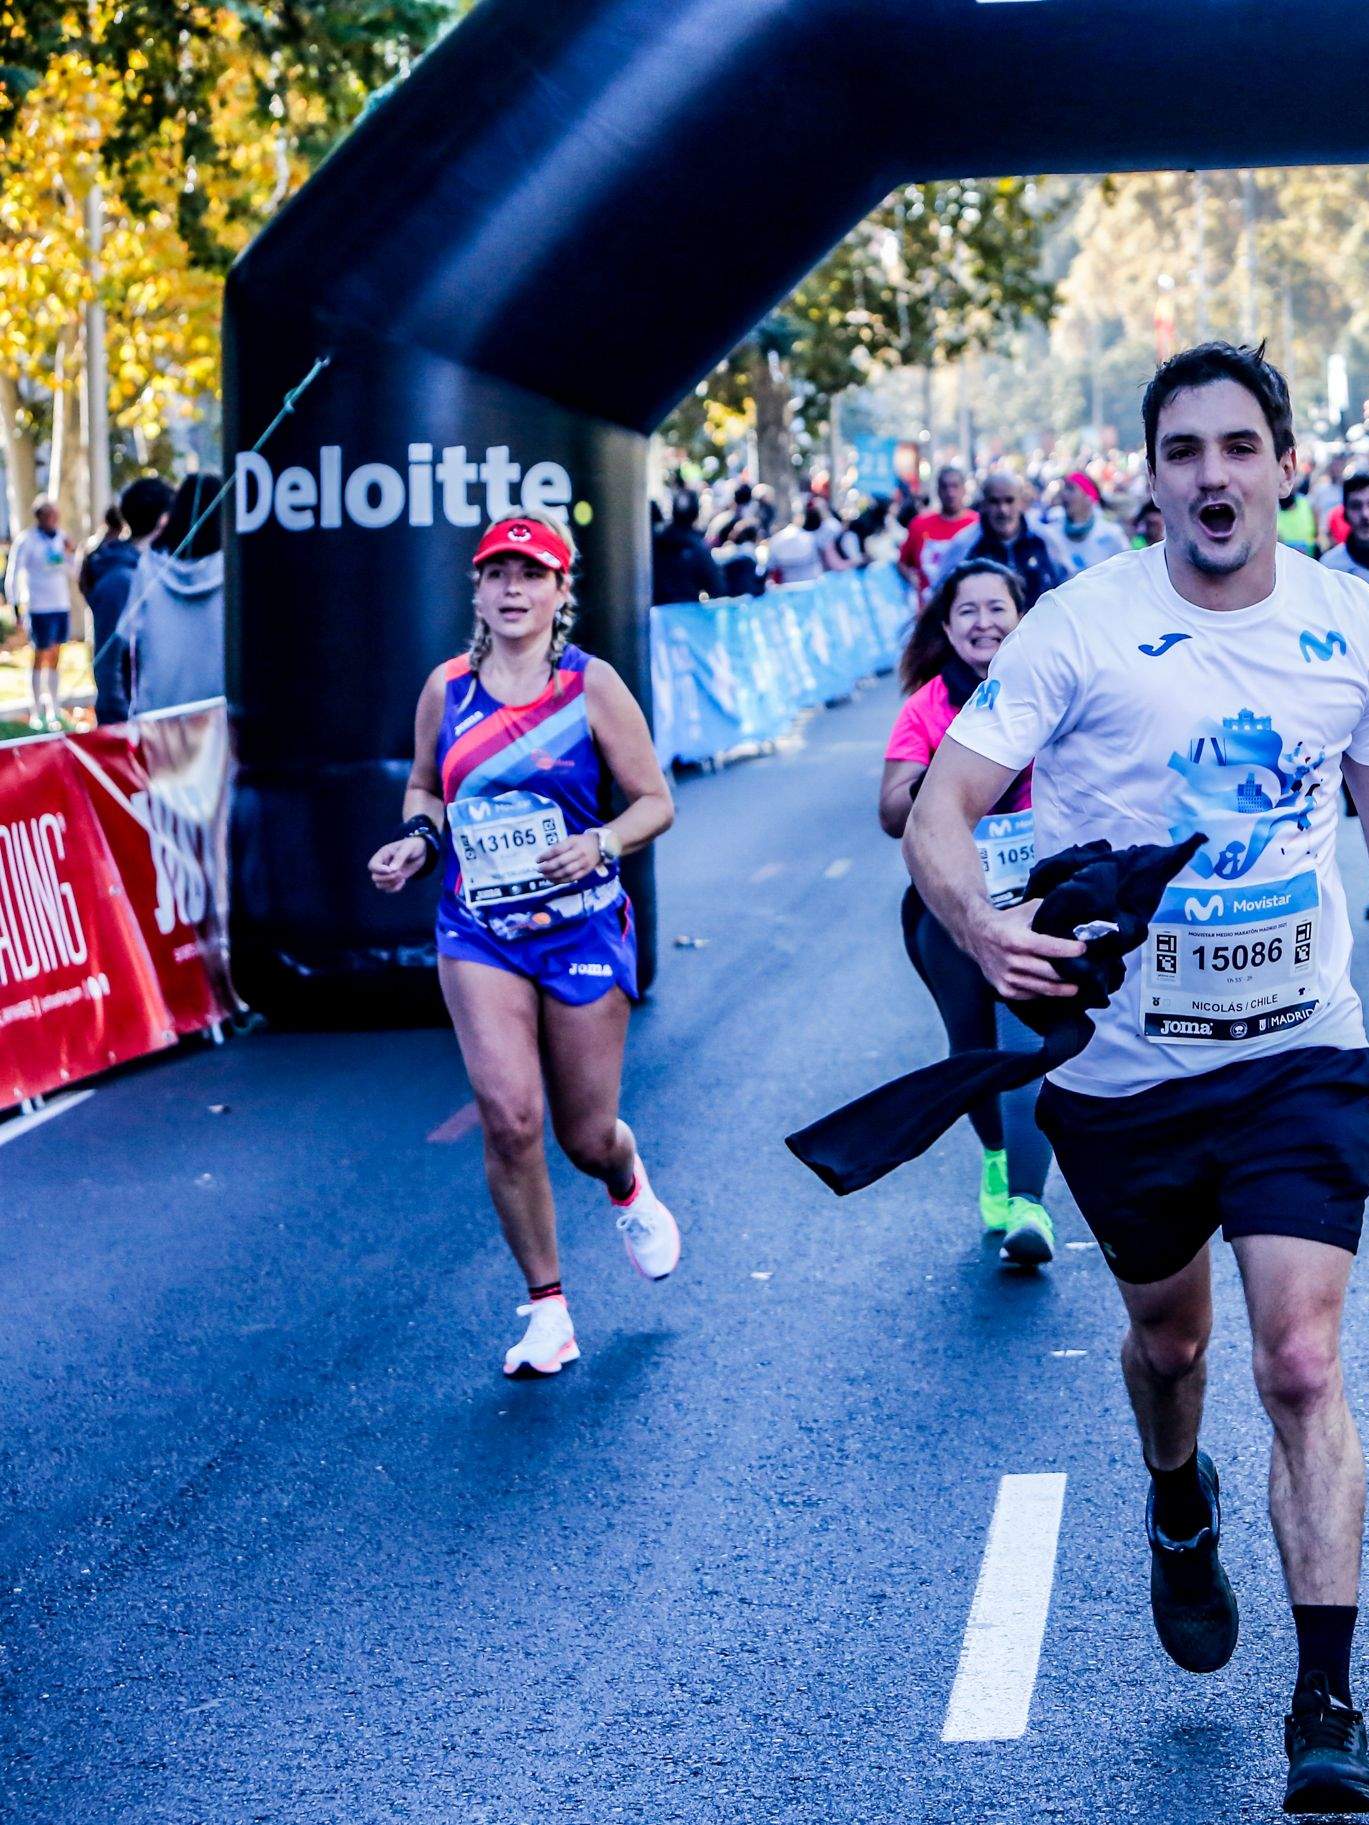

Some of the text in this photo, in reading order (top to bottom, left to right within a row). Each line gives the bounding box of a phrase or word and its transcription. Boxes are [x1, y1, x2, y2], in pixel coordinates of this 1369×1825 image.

[477, 827, 537, 855] 13165
[1232, 893, 1293, 914] Movistar
[1191, 936, 1284, 972] 15086
[1191, 1000, 1244, 1013] NICOLÁS
[1250, 994, 1279, 1009] CHILE
[1270, 1007, 1316, 1028] MADRID
